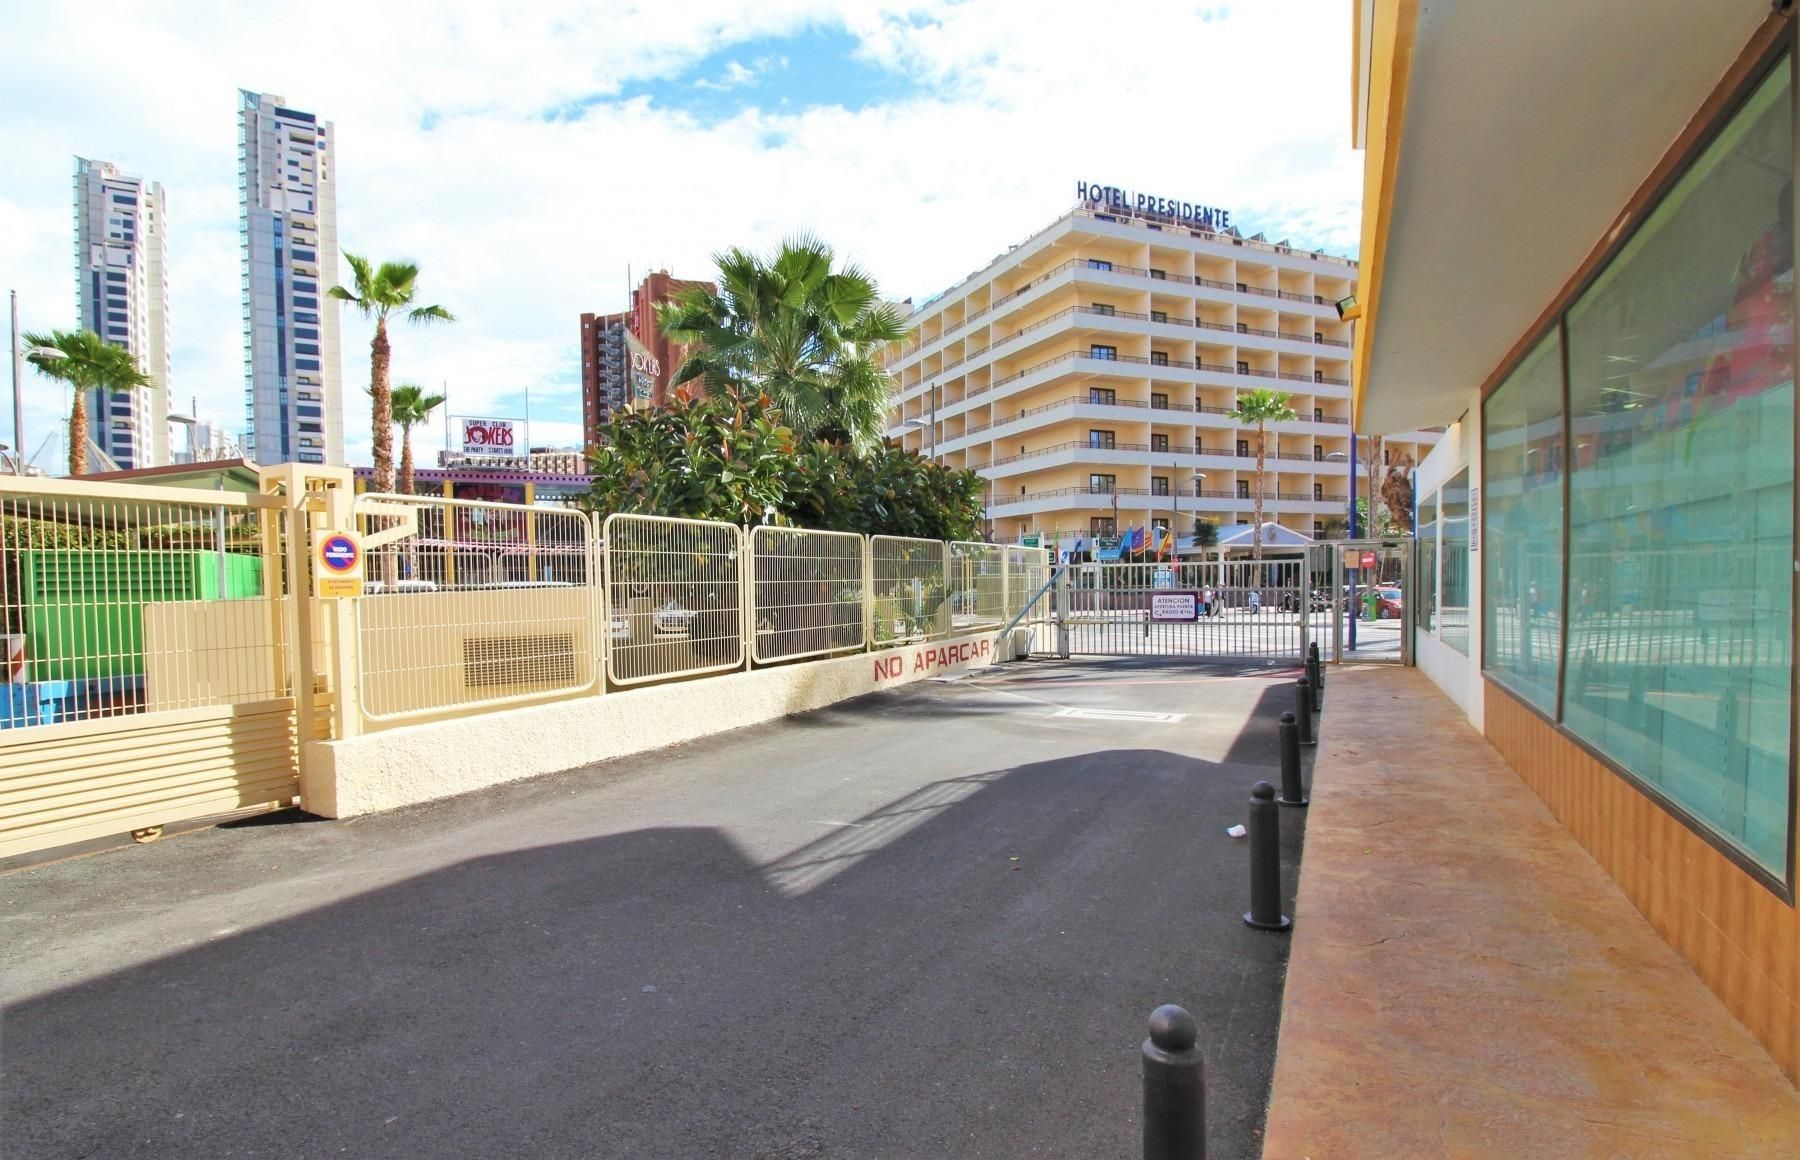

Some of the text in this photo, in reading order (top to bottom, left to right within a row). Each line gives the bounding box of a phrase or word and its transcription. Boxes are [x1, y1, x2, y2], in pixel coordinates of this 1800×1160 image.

[1077, 180, 1230, 228] HOTEL PRESIDENTE
[463, 425, 514, 446] JOKERS
[469, 418, 507, 428] SUPER CLUB
[874, 639, 990, 682] NO APARCAR
